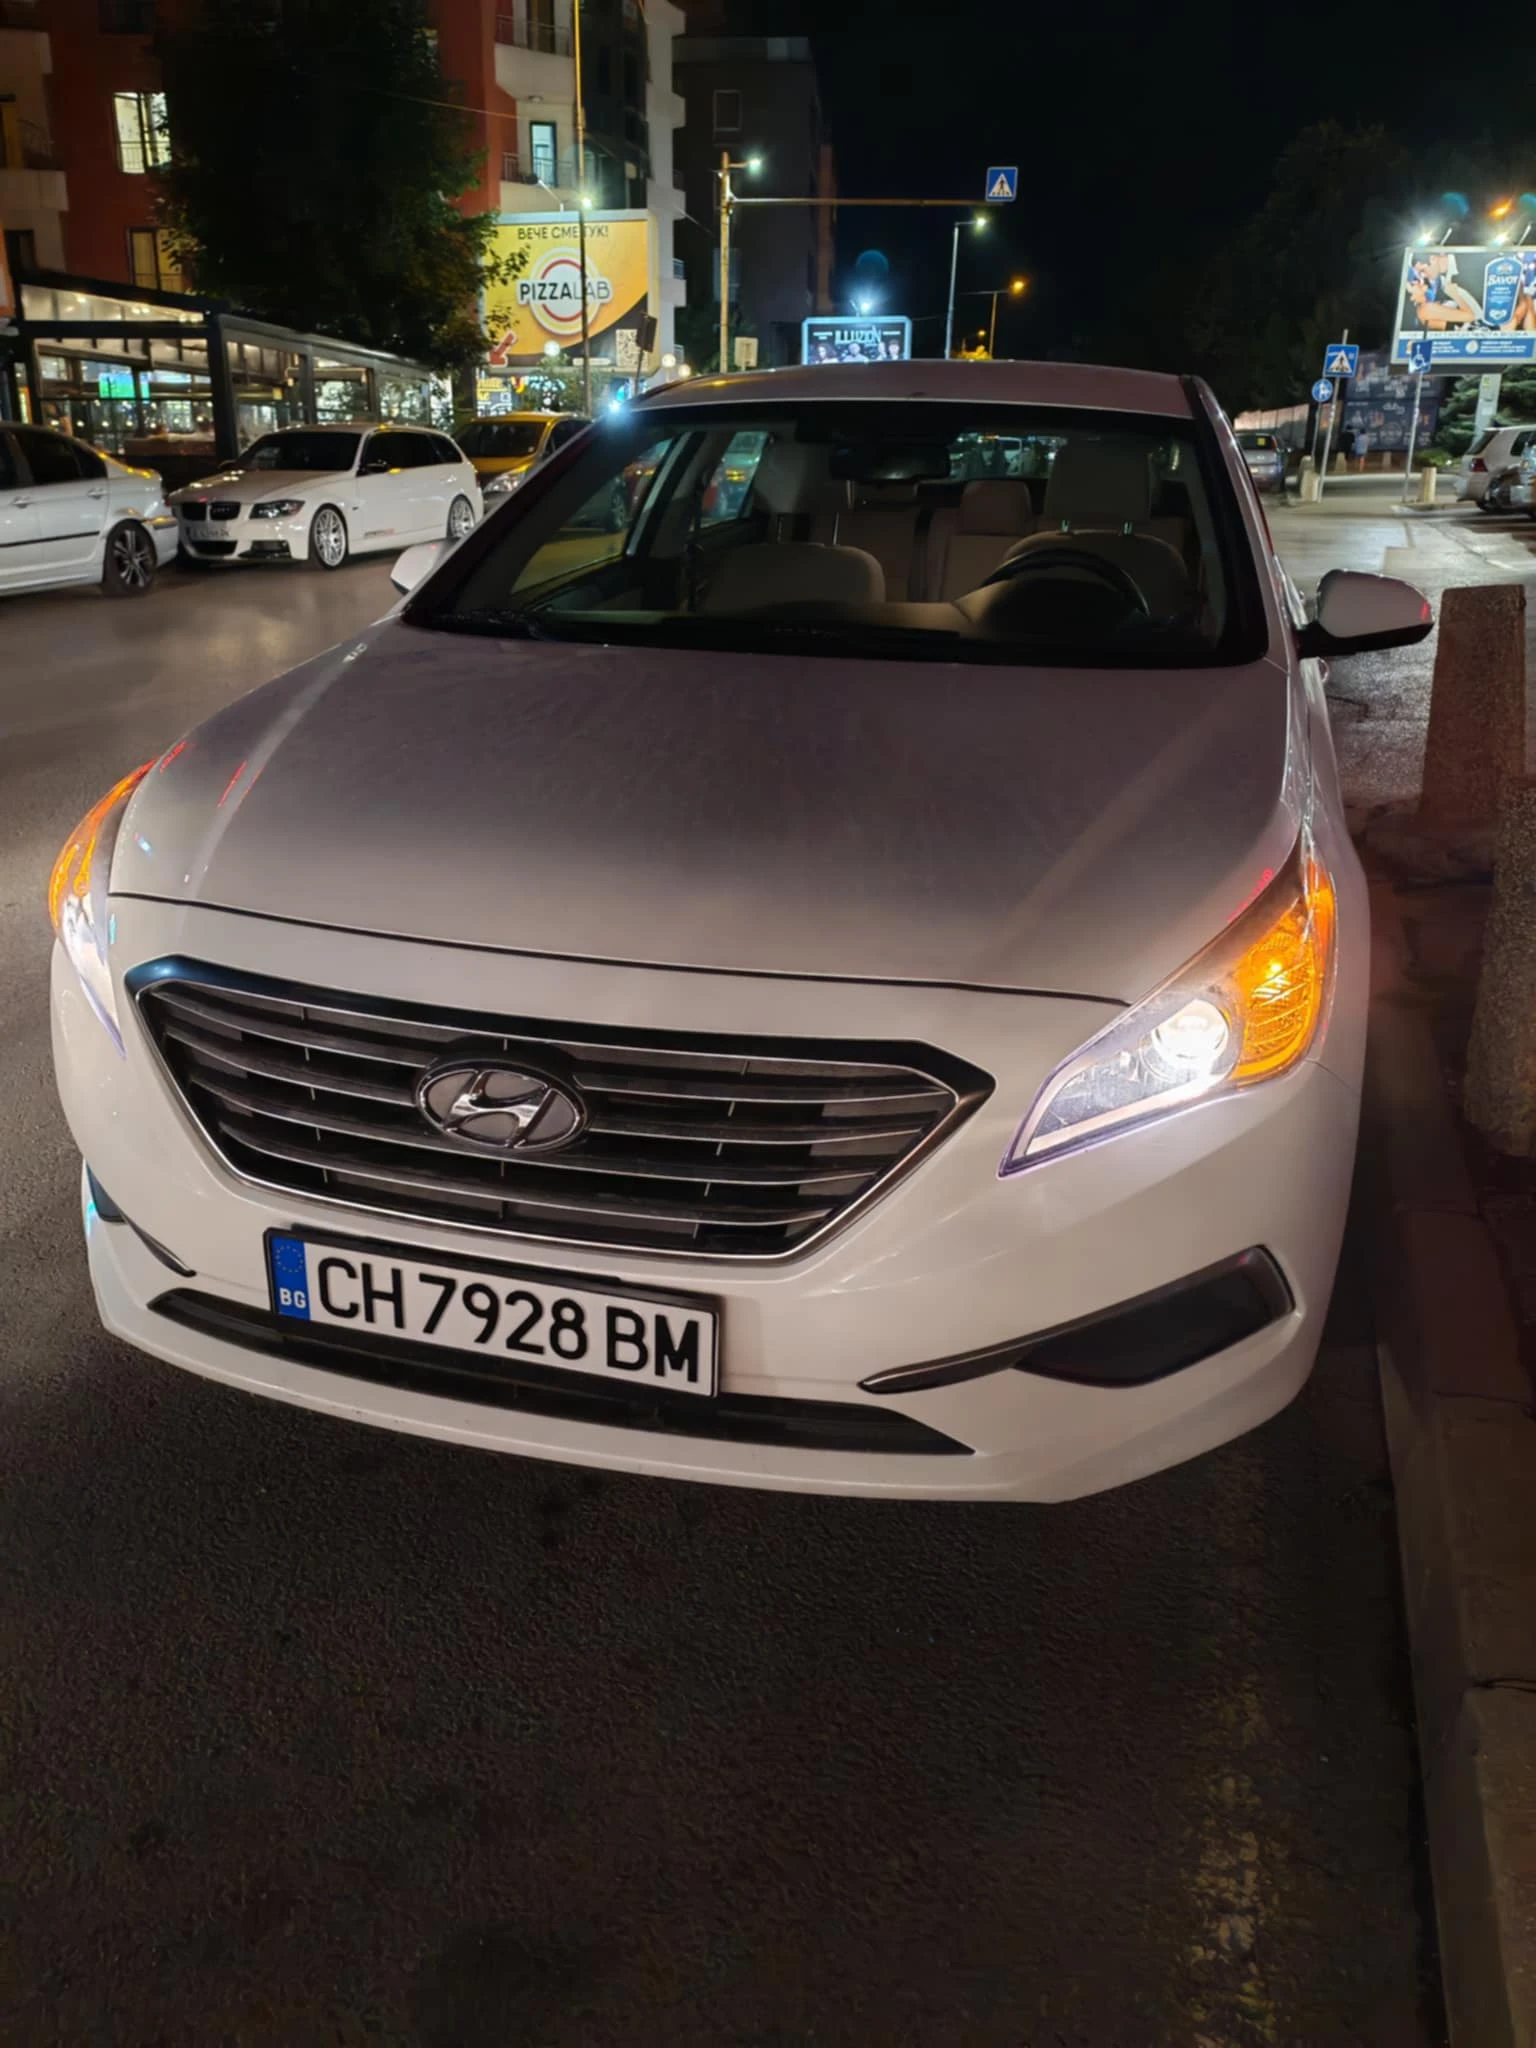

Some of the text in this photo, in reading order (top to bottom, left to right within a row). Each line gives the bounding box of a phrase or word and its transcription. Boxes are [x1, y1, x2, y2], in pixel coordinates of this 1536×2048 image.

[517, 226, 549, 240] ВЕЧЕ
[519, 281, 611, 301] PIZZALAB
[279, 1287, 307, 1310] BG
[317, 1257, 700, 1384] CH 7928 BM
